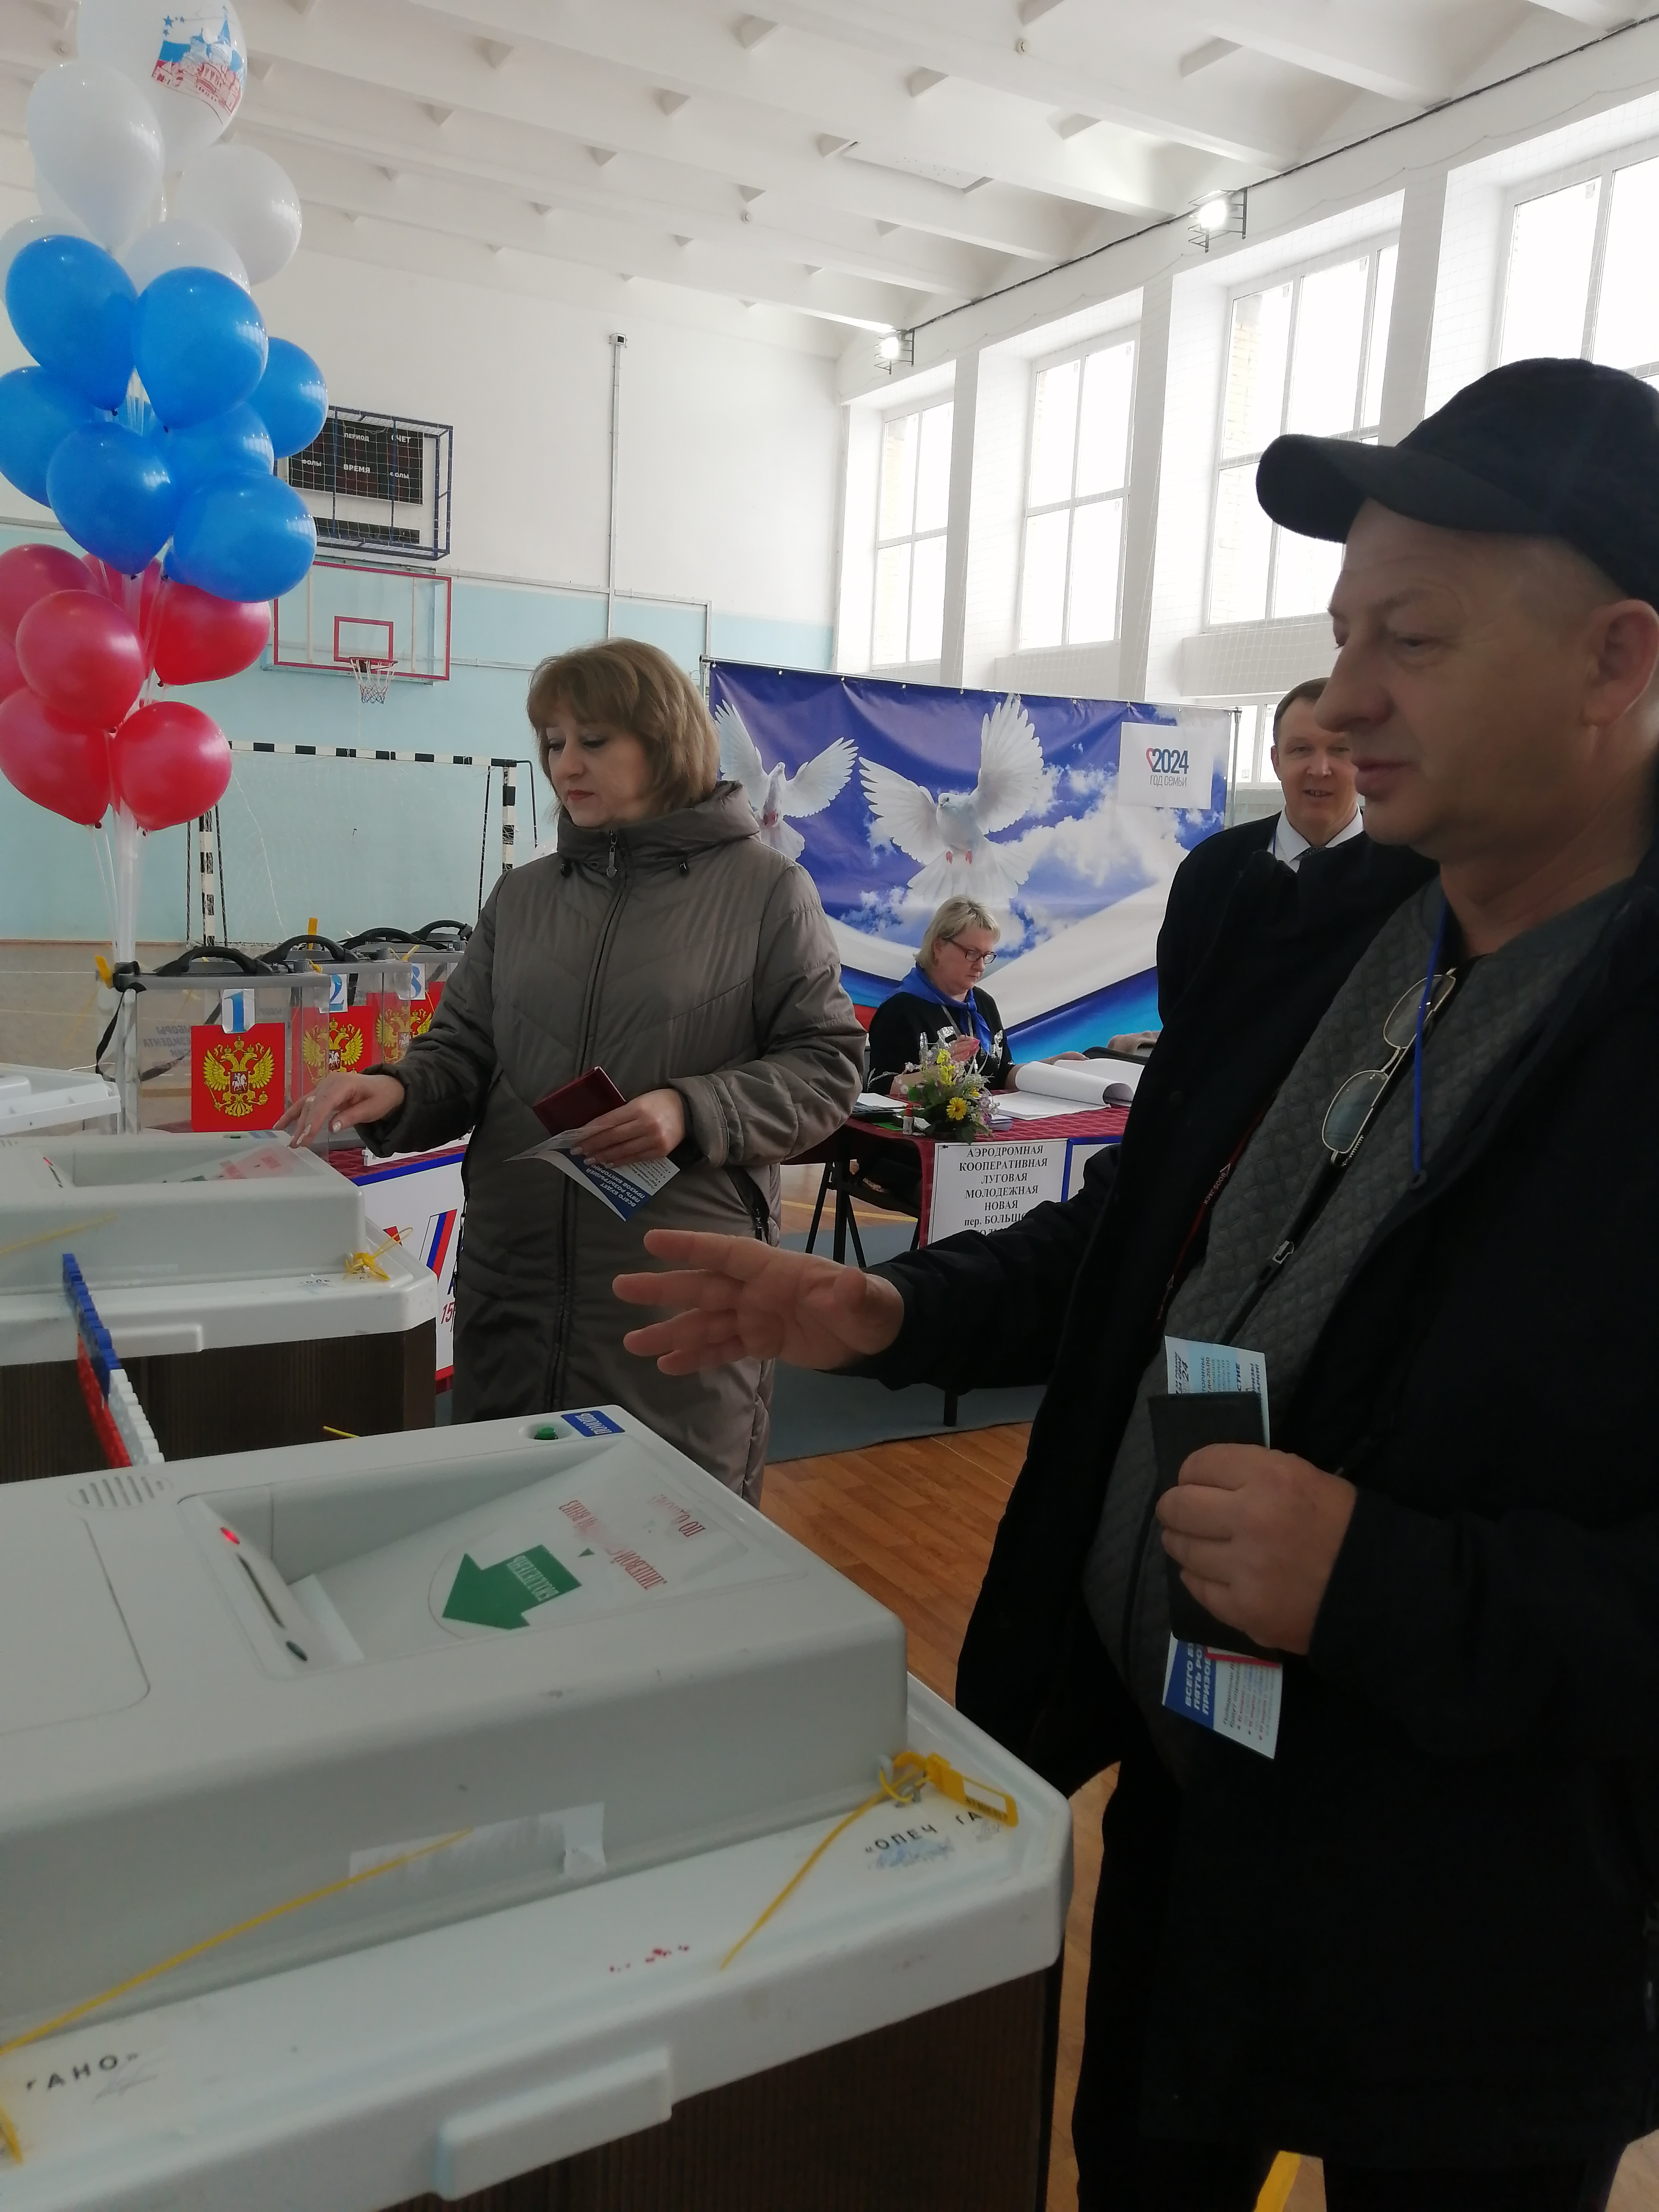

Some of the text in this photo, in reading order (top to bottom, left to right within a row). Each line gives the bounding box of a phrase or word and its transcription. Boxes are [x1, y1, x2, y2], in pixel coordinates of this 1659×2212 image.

[344, 433, 369, 441] ПЕРИОД
[344, 464, 370, 473] ВРЕМЯ
[1152, 748, 1189, 774] 2024
[1150, 775, 1163, 787] ГОД
[224, 991, 249, 1033] 1
[967, 1145, 1043, 1157] АЭРОДРОМНАЯ
[959, 1158, 1047, 1171] КООПЕРАТИВНАЯ
[981, 1172, 1027, 1184] ЛУГОВАЯ
[600, 1183, 636, 1207] ВСЕГО БУДЕТ
[622, 1183, 646, 1199] ПРИЗОВ
[965, 1185, 1038, 1198] МОЛОДЕЖНАЯ
[1203, 1189, 1214, 1205] JACK
[985, 1200, 1018, 1211] НОВАЯ
[964, 1218, 981, 1228] пер.
[575, 1413, 613, 1436] ПОМОЩЬ
[679, 1521, 706, 1537] ПО
